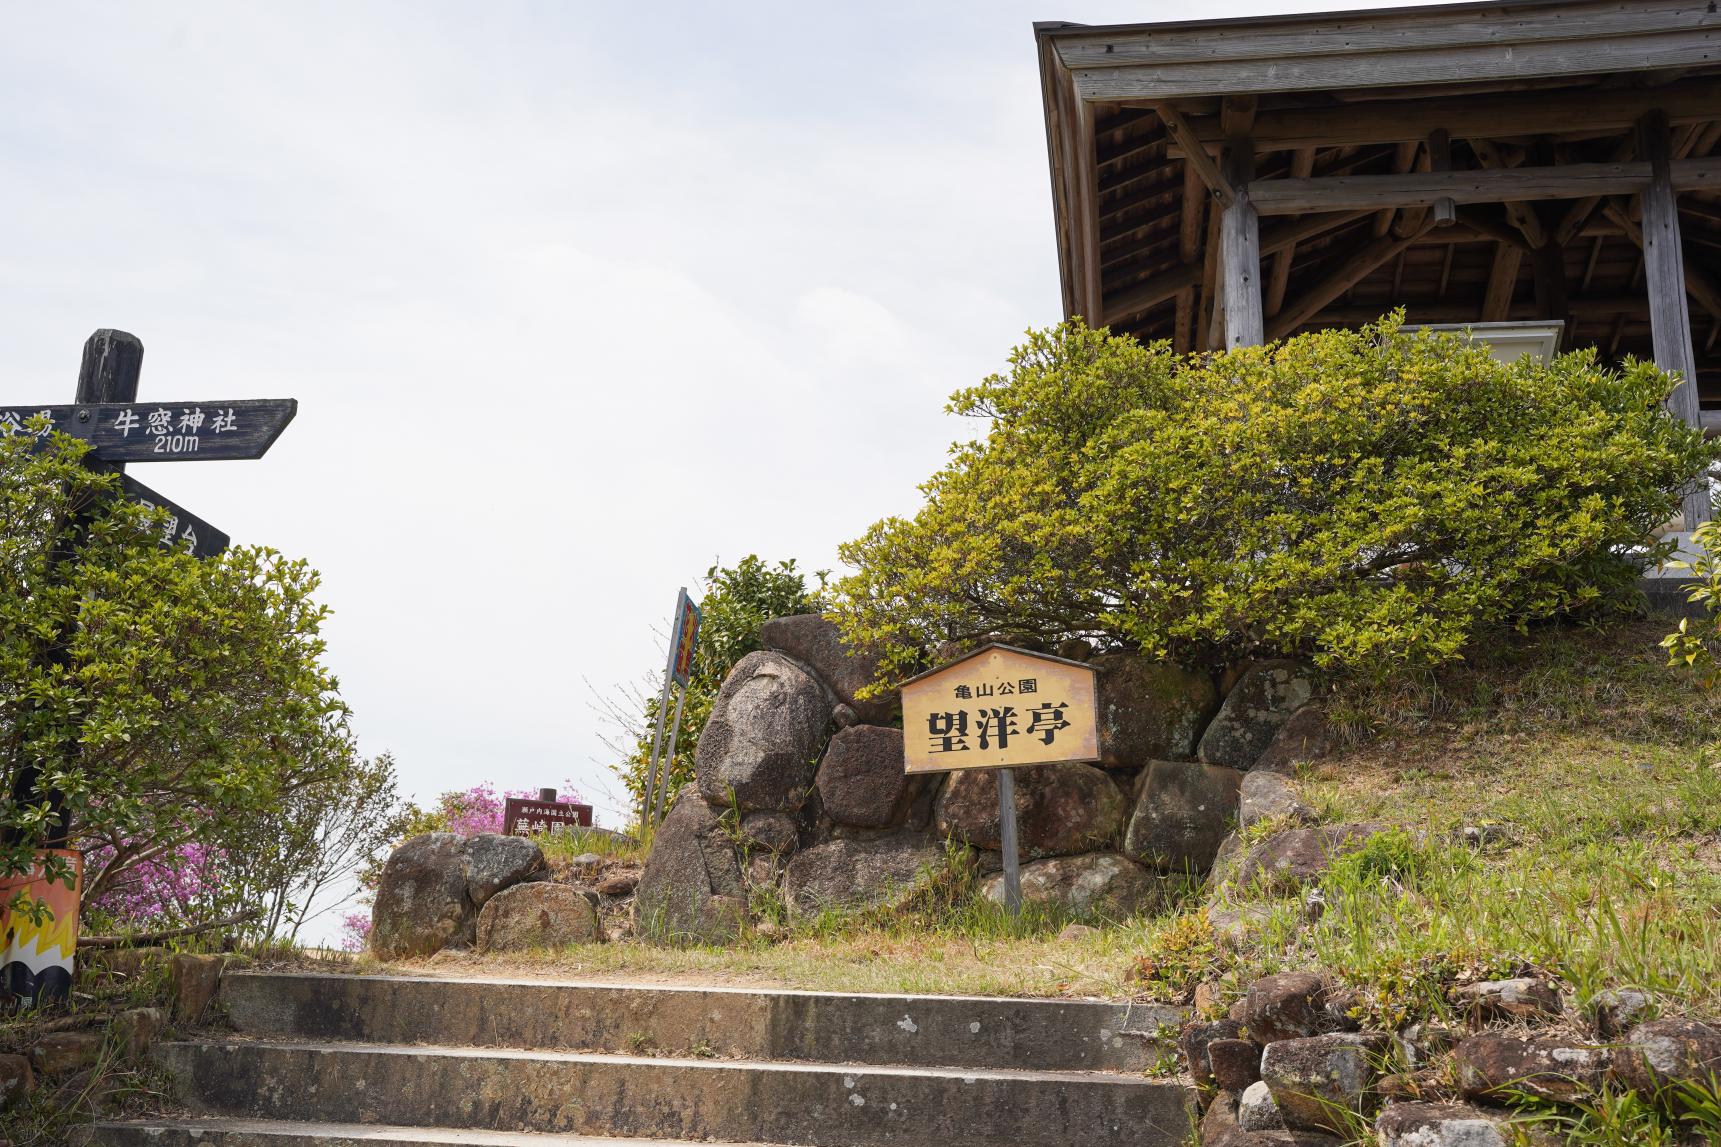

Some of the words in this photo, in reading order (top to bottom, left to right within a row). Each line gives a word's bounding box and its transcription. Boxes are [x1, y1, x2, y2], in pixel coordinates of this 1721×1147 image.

[113, 407, 238, 438] 牛窓神社
[153, 435, 199, 453] 210m
[953, 678, 1038, 700] 亀山公園
[926, 701, 1071, 754] 望洋亭
